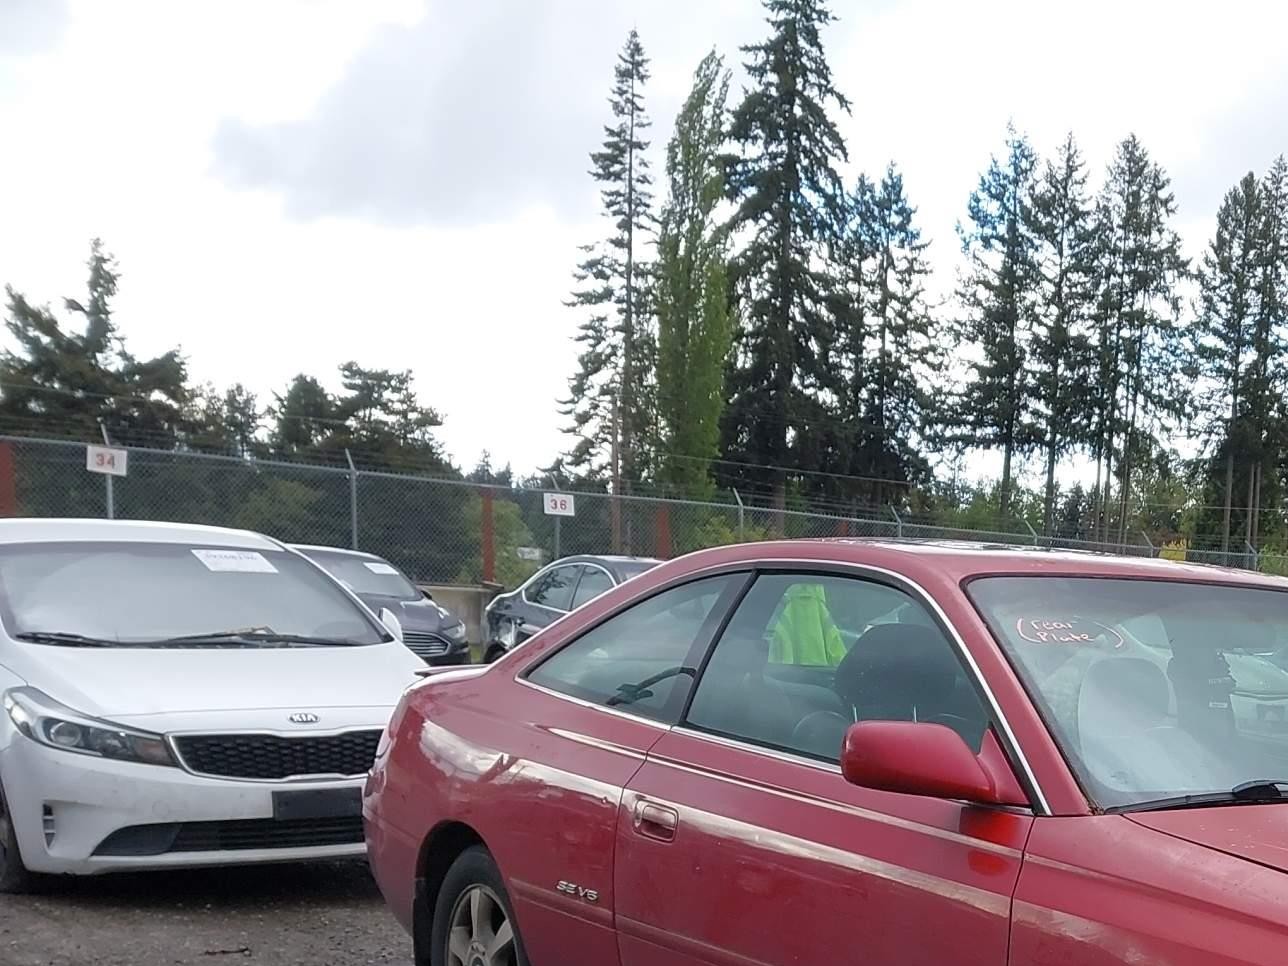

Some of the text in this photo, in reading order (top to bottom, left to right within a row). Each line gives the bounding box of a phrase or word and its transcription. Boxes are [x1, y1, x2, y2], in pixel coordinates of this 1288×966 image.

[550, 498, 567, 511] 36
[289, 711, 319, 723] KIA
[556, 880, 598, 901] SE V6
